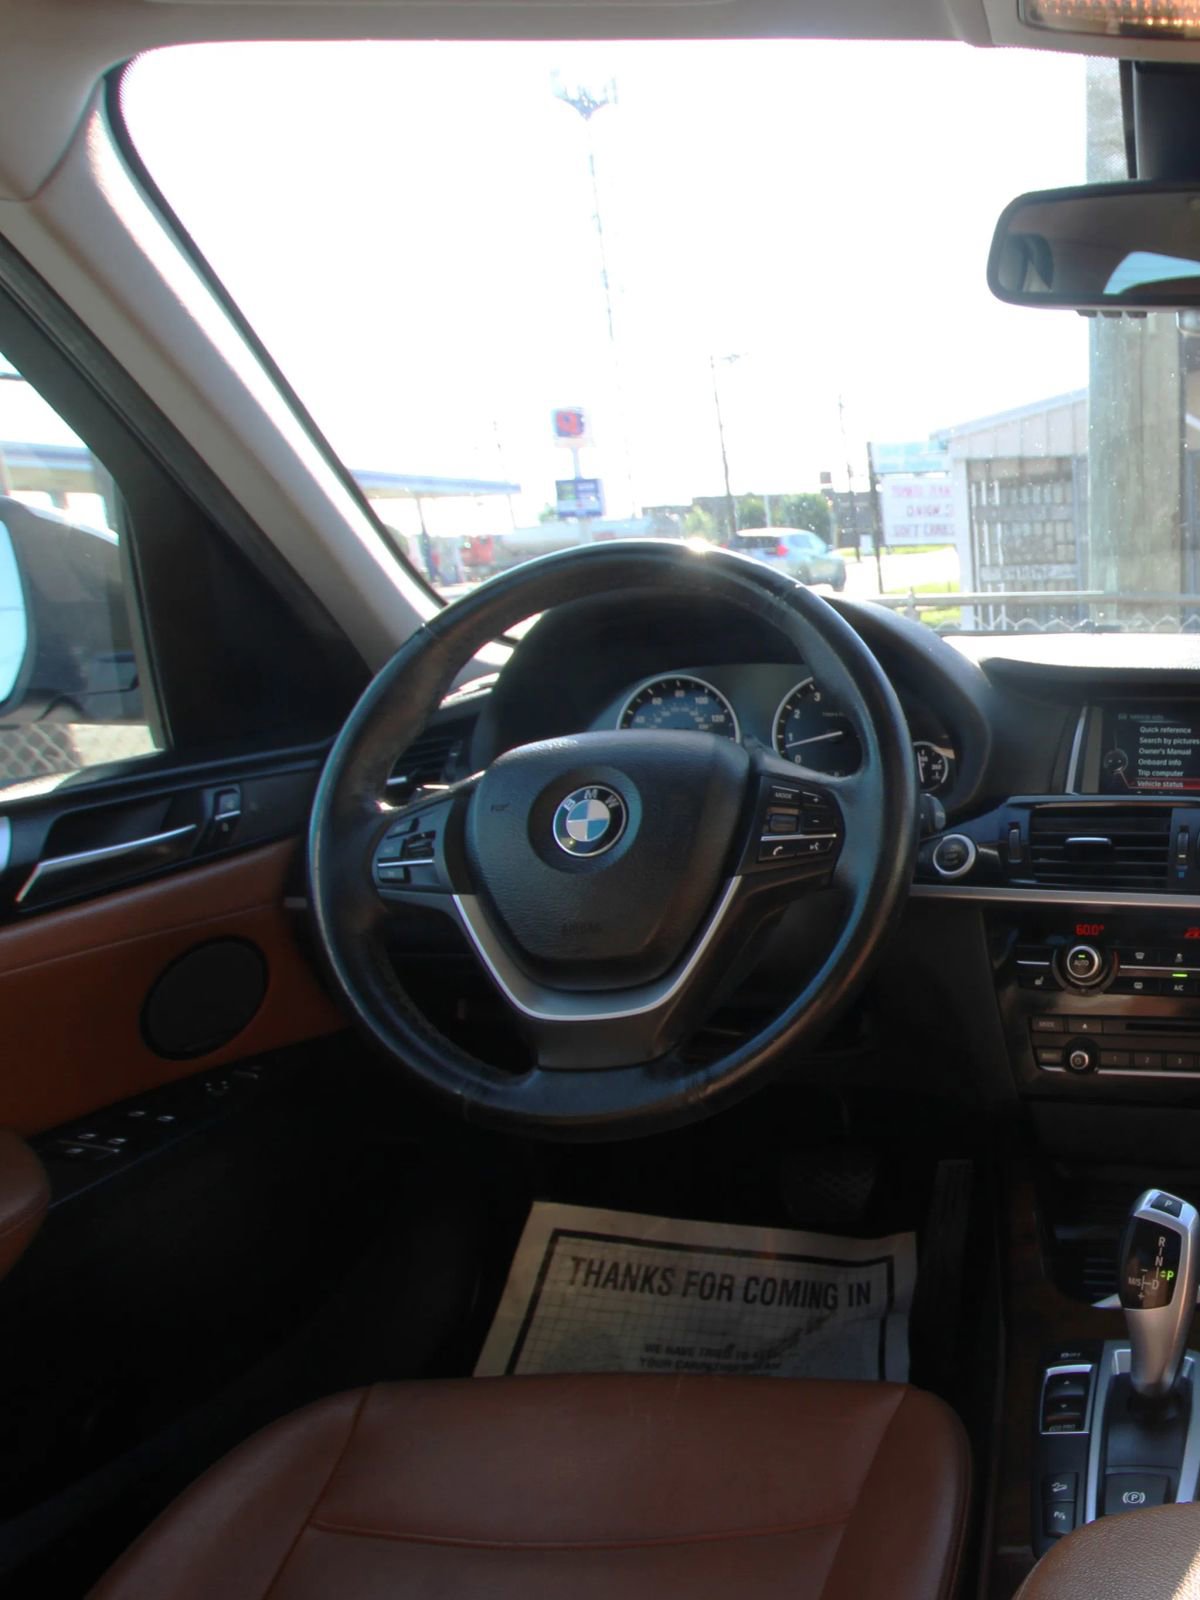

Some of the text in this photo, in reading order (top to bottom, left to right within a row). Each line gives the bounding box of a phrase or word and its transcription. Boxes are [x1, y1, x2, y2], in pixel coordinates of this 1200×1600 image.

[814, 692, 821, 702] 3
[794, 709, 801, 719] 2
[1139, 726, 1159, 734] Quick
[1138, 758, 1167, 766] Onboard
[1138, 769, 1151, 777] Trip
[1137, 780, 1161, 788] Vehicle
[563, 788, 619, 811] BMW
[1164, 1200, 1172, 1208] P
[1158, 1236, 1166, 1247] R
[1155, 1256, 1163, 1267] N
[1166, 1270, 1174, 1280] P
[568, 1255, 871, 1310] THANKS FOR COMING IN
[1151, 1279, 1160, 1290] D
